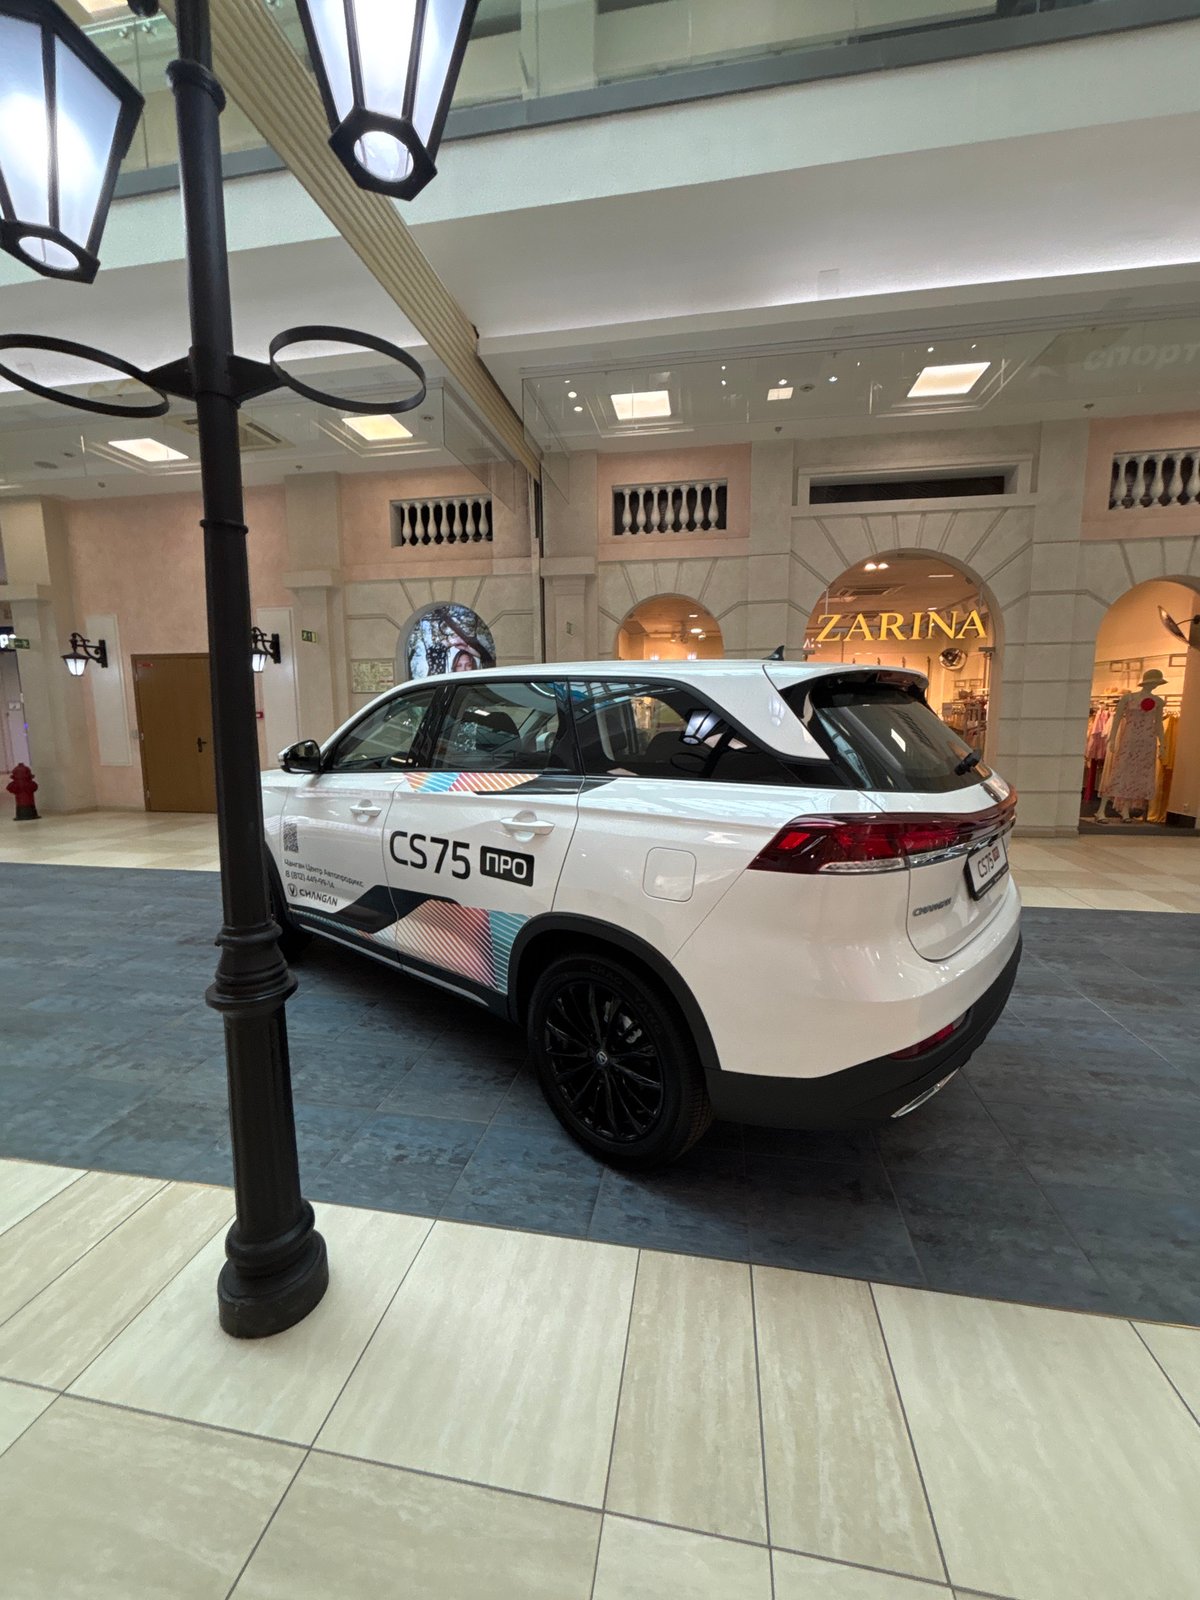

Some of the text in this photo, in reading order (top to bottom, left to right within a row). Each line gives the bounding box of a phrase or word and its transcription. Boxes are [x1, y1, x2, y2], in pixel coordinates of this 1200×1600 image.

[815, 609, 987, 642] ZARINA
[389, 830, 527, 880] CS75 ПРО
[299, 889, 338, 906] CHANGAN
